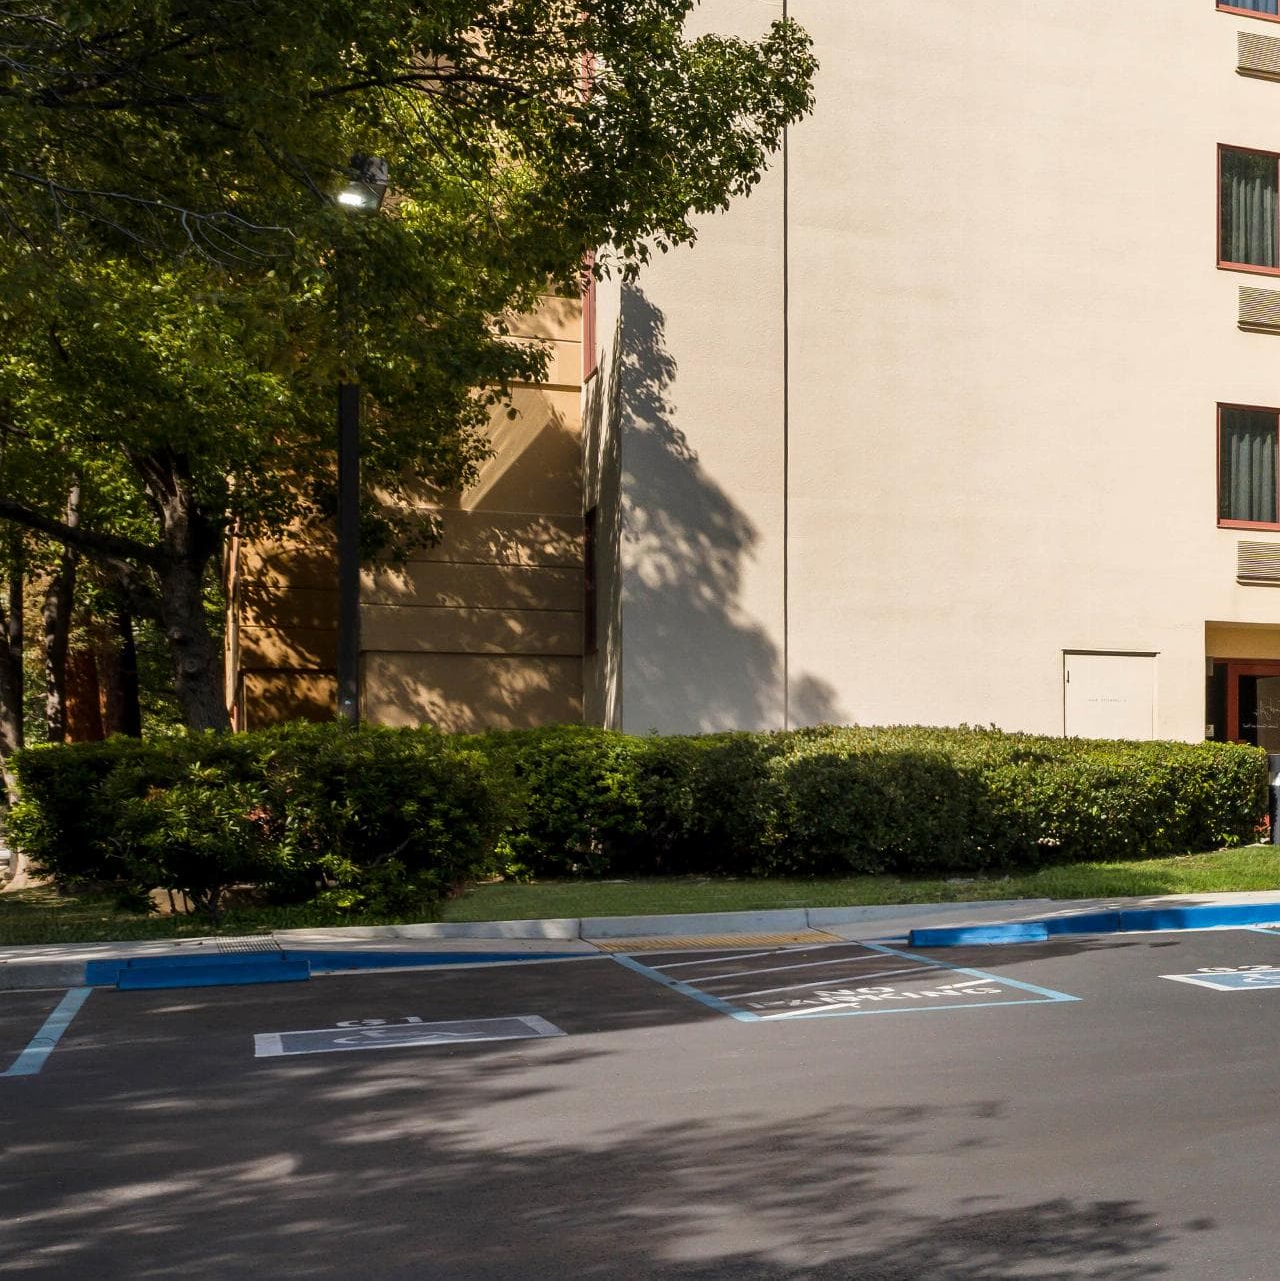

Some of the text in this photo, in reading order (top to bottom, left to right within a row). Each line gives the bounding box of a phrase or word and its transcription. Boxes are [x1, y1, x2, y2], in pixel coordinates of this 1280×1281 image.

[746, 987, 1002, 1008] PARKING
[813, 986, 895, 997] NO
[336, 1016, 423, 1028] 61
